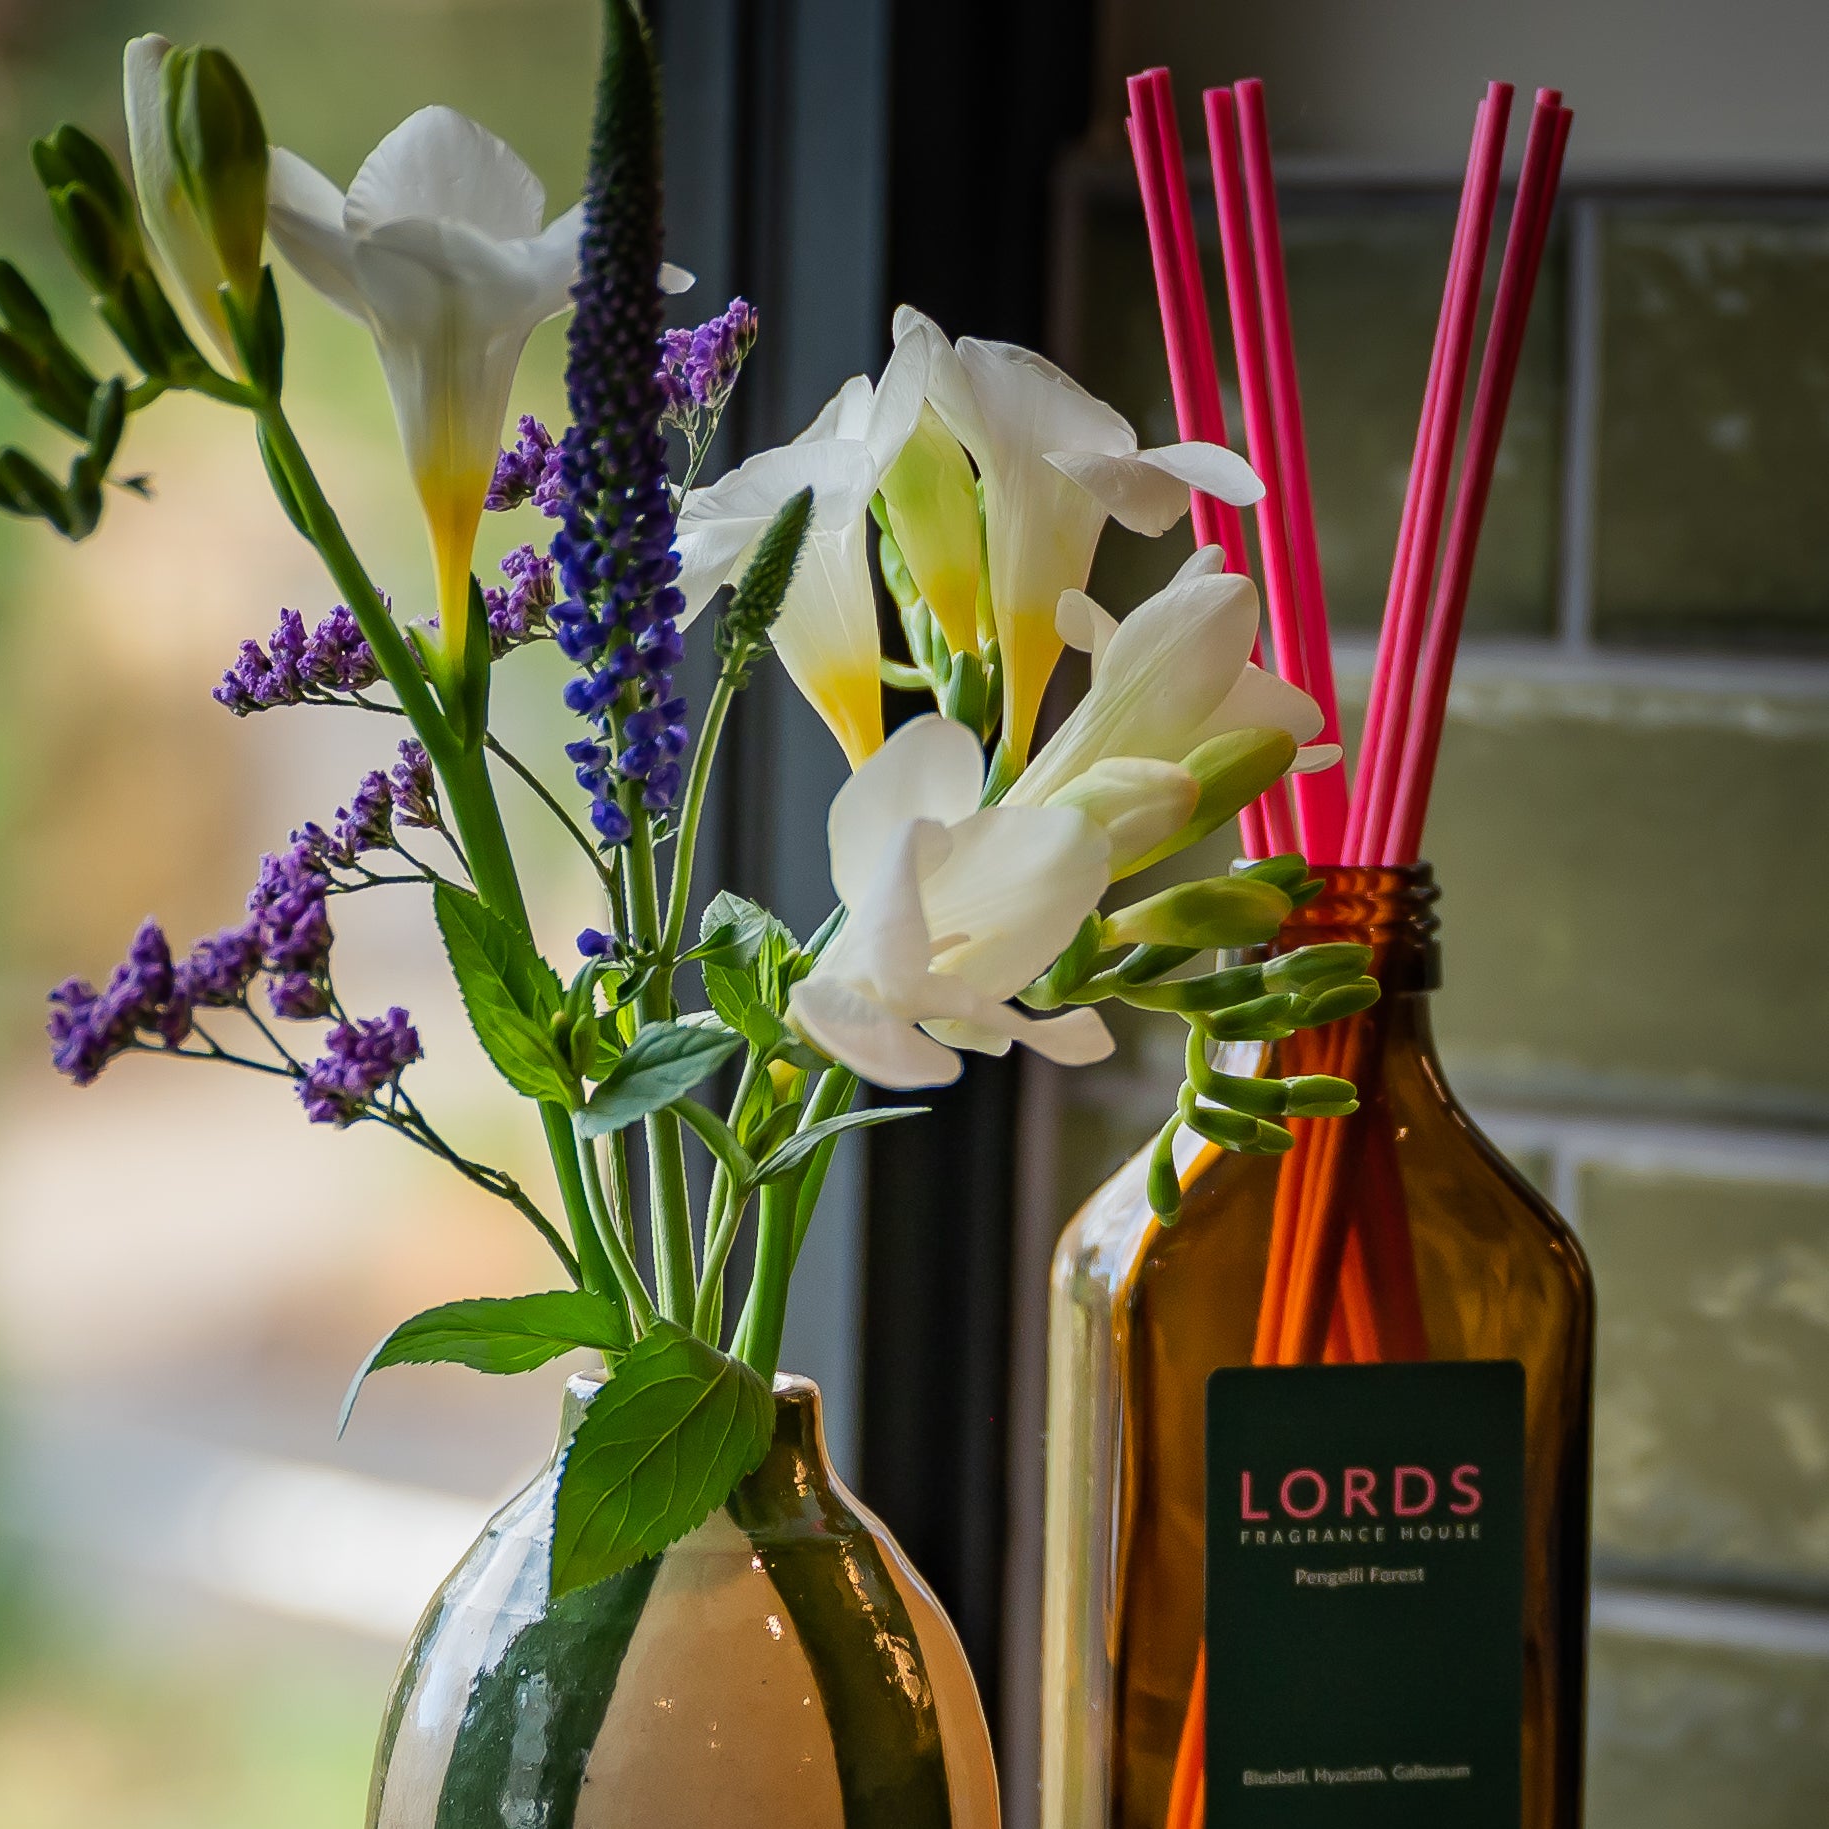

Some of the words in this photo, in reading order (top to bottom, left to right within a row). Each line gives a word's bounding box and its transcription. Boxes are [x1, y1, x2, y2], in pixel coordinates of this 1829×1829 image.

[1240, 1464, 1483, 1520] LORDS
[1240, 1527, 1386, 1545] FRAGRANCE
[1400, 1524, 1480, 1541] HOUSE
[1369, 1566, 1425, 1583] Forest
